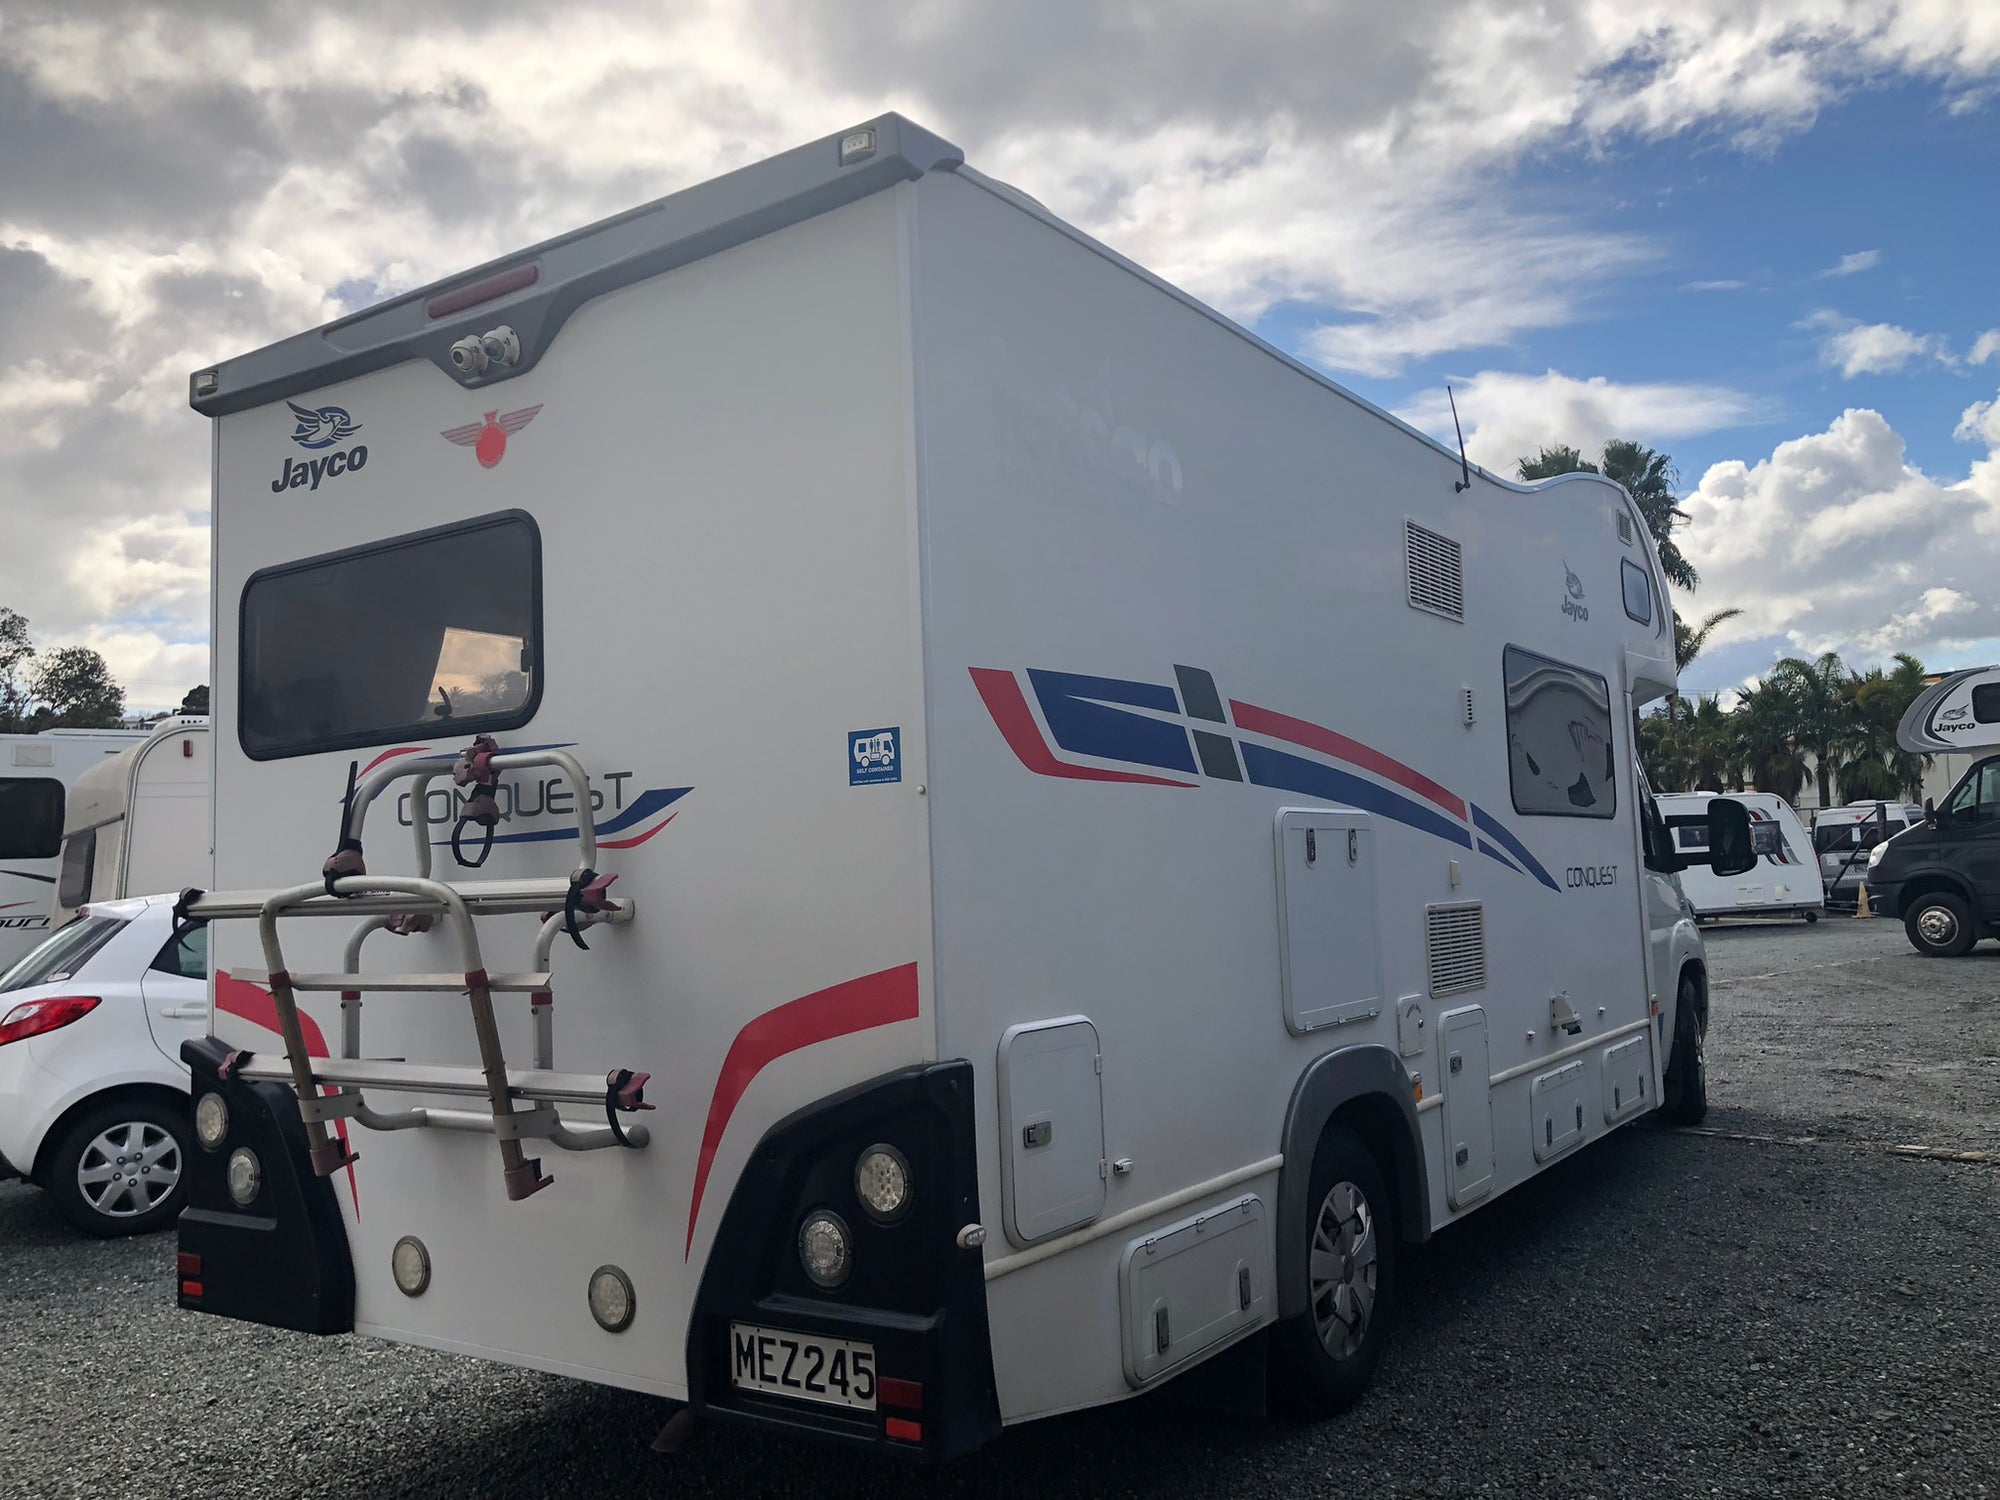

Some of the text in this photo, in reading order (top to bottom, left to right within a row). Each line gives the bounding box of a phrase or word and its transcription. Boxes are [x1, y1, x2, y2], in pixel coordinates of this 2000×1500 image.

[271, 445, 368, 493] Jayco
[1561, 594, 1589, 622] Jayco
[1934, 722, 1976, 733] Jayco
[1566, 865, 1618, 888] CONQUEST
[735, 1332, 875, 1400] MEZ245
